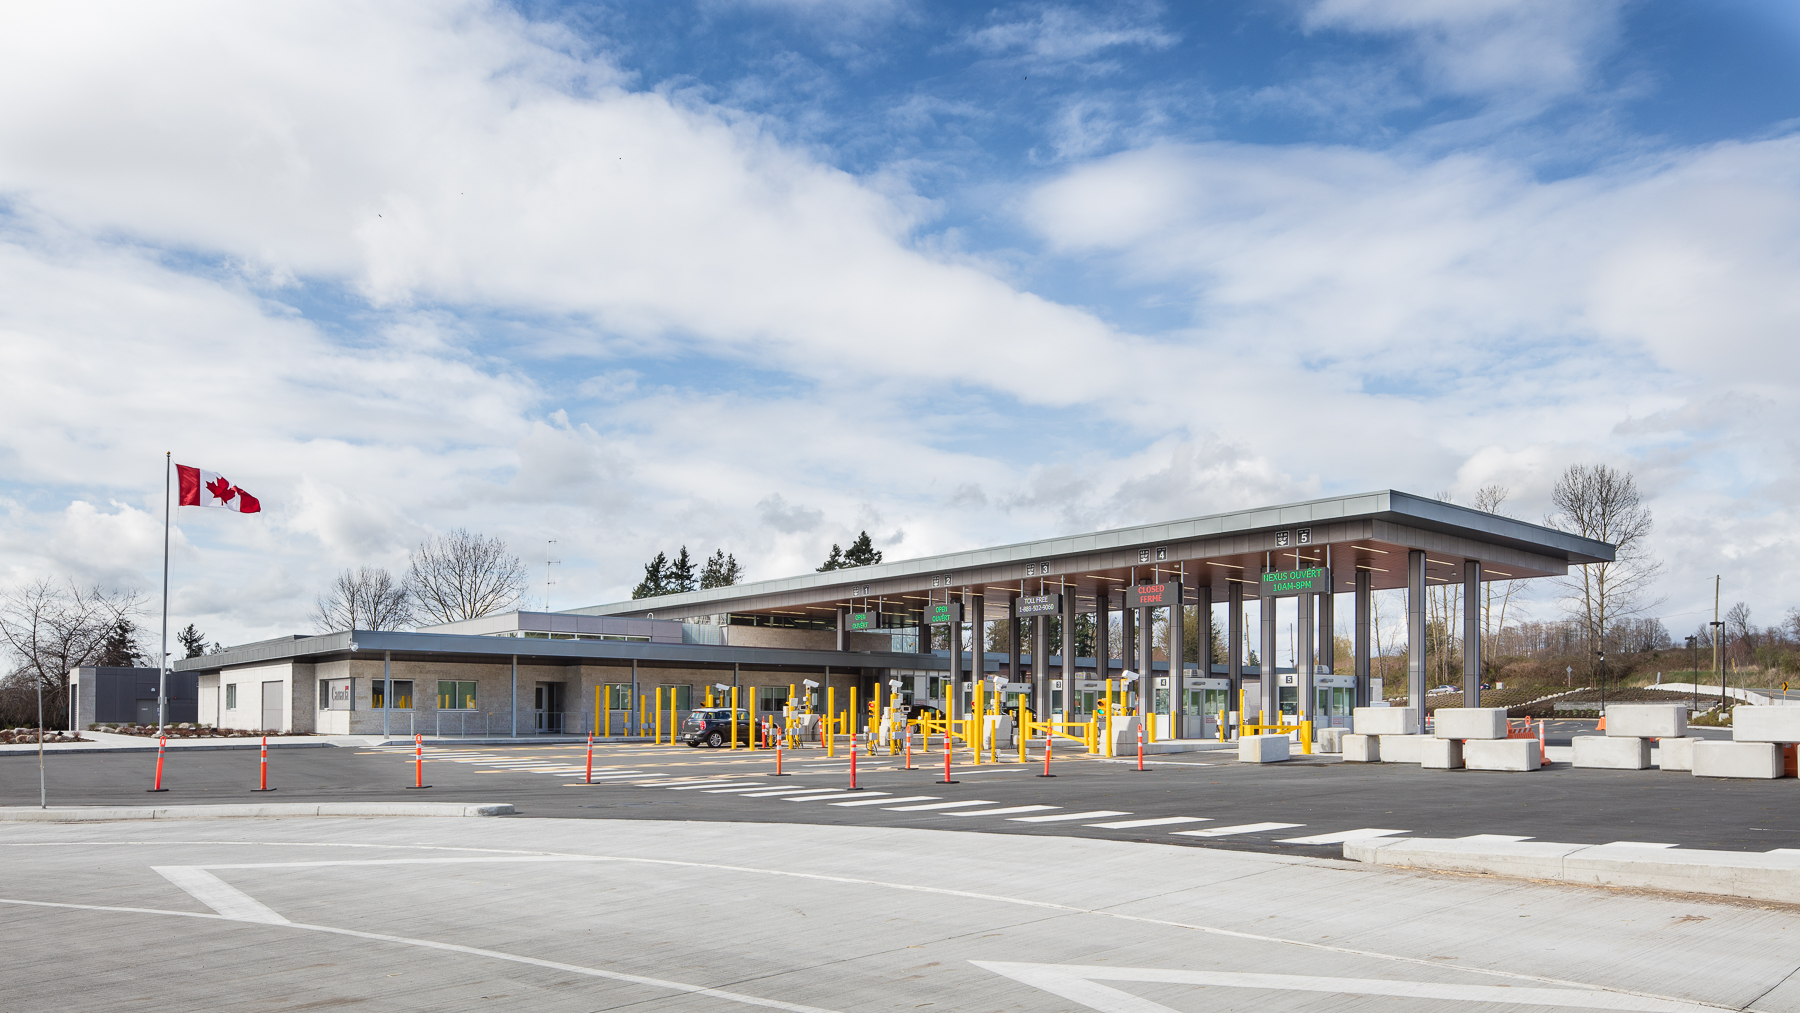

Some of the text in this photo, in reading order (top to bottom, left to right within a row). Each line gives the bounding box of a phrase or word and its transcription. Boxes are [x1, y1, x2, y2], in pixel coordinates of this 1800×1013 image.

[1301, 534, 1307, 542] 5
[1263, 572, 1288, 582] NEXUS
[1138, 584, 1165, 594] CLOSED
[1273, 581, 1312, 592] 10AM-8PM
[1140, 593, 1162, 603] FERMÉ
